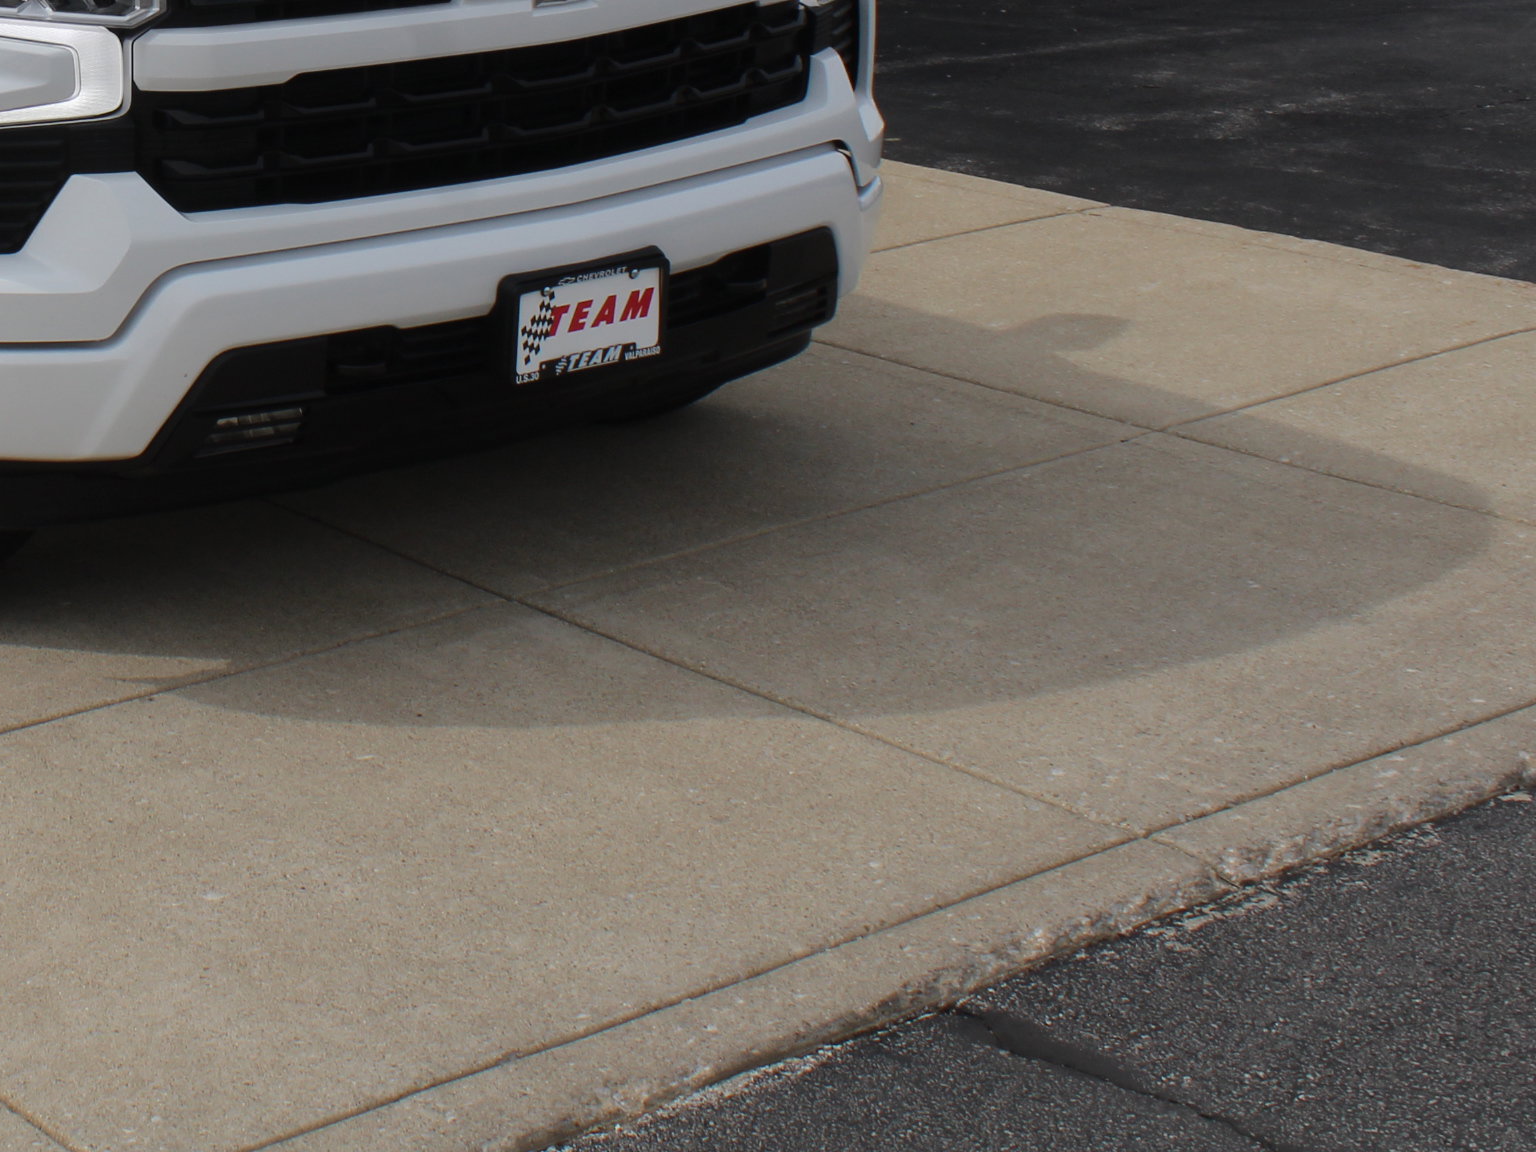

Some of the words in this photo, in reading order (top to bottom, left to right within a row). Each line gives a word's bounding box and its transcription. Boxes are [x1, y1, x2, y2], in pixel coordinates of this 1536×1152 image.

[576, 266, 627, 283] CHEVROLET
[548, 287, 655, 337] TEAM
[567, 344, 623, 373] TEAM
[624, 345, 661, 360] VALPARAISO
